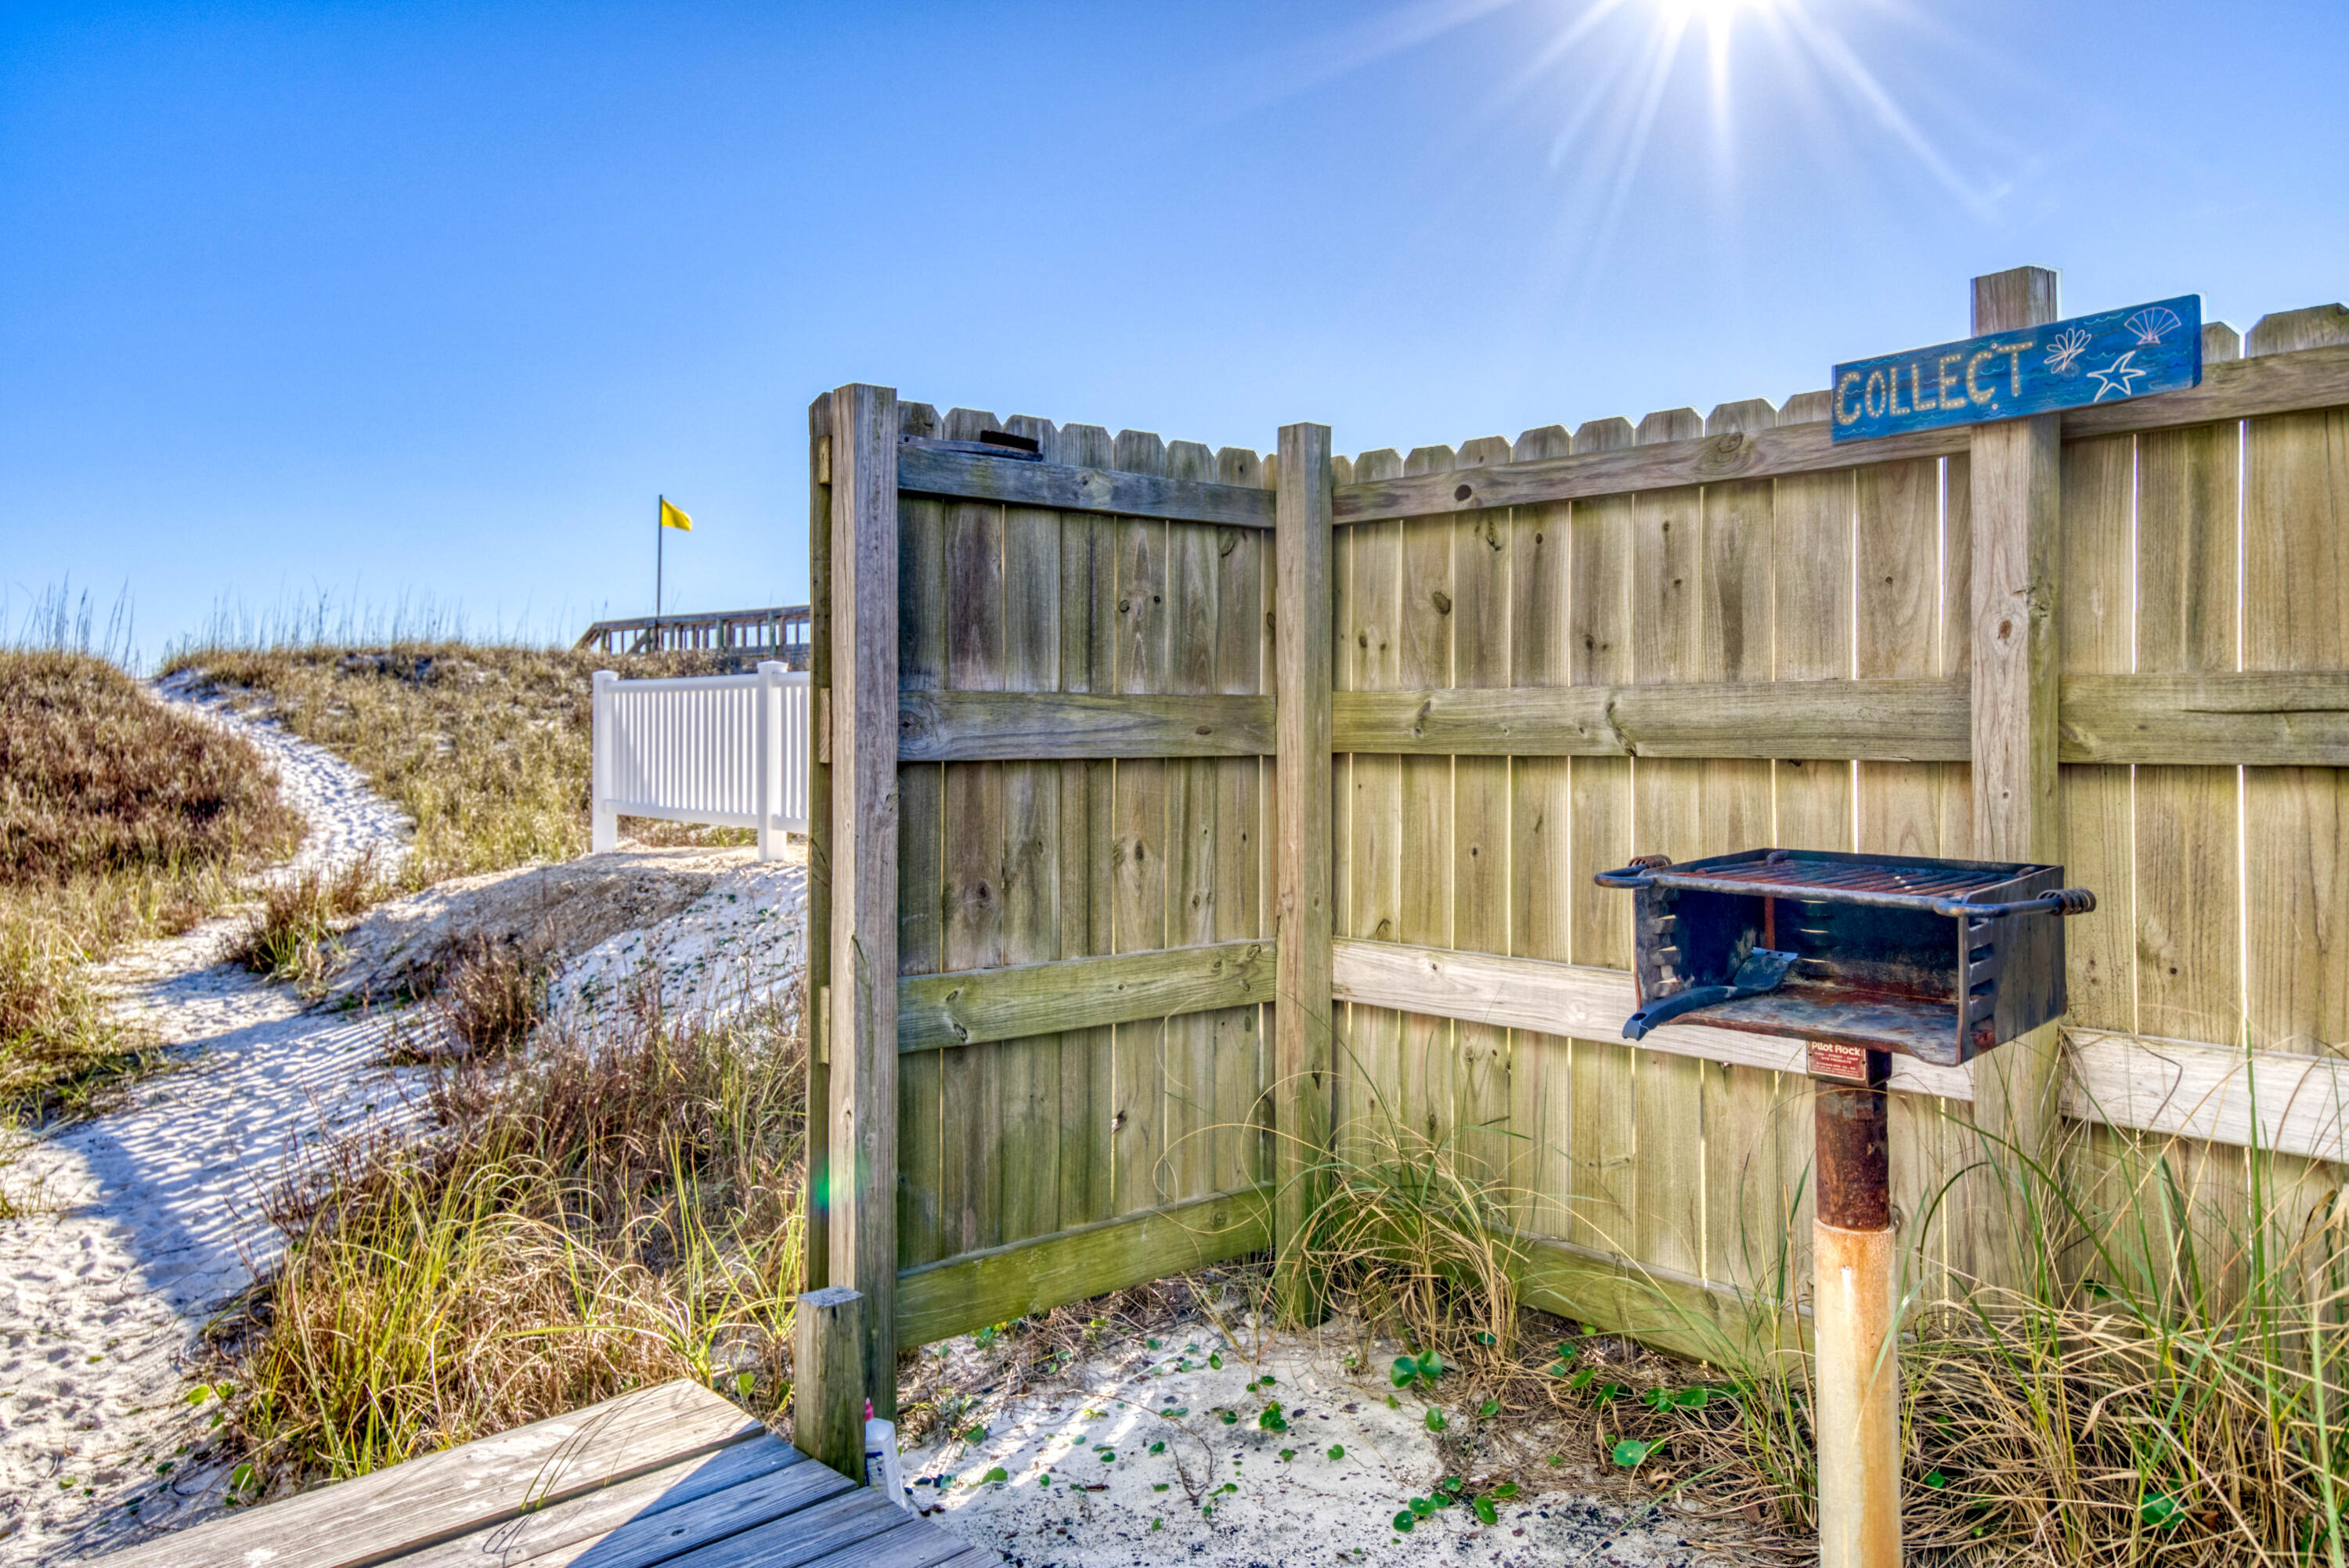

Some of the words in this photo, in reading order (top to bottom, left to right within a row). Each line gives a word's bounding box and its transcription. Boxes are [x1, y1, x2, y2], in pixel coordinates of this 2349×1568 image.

[1836, 341, 2033, 426] COLLECT
[1811, 1042, 1833, 1052] Pilot
[1835, 1045, 1860, 1056] Rock
